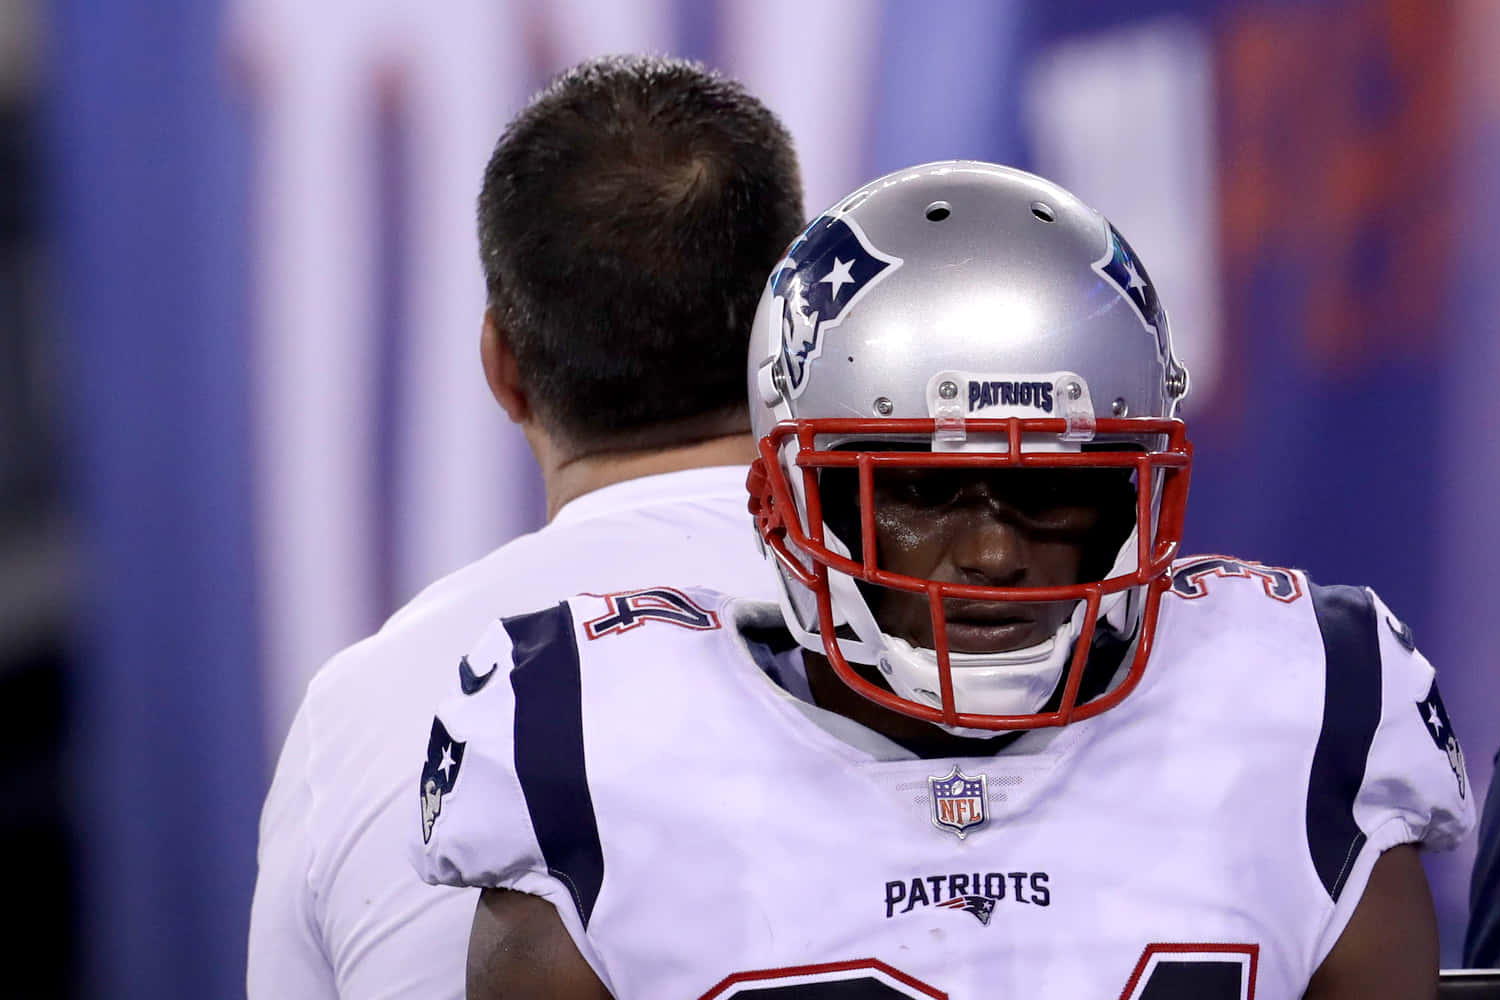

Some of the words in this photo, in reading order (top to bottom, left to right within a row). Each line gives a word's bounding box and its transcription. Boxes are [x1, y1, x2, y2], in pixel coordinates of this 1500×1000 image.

[968, 381, 1053, 412] PATRIOTS
[939, 799, 981, 825] NFL
[885, 872, 1051, 918] PATRIOTS
